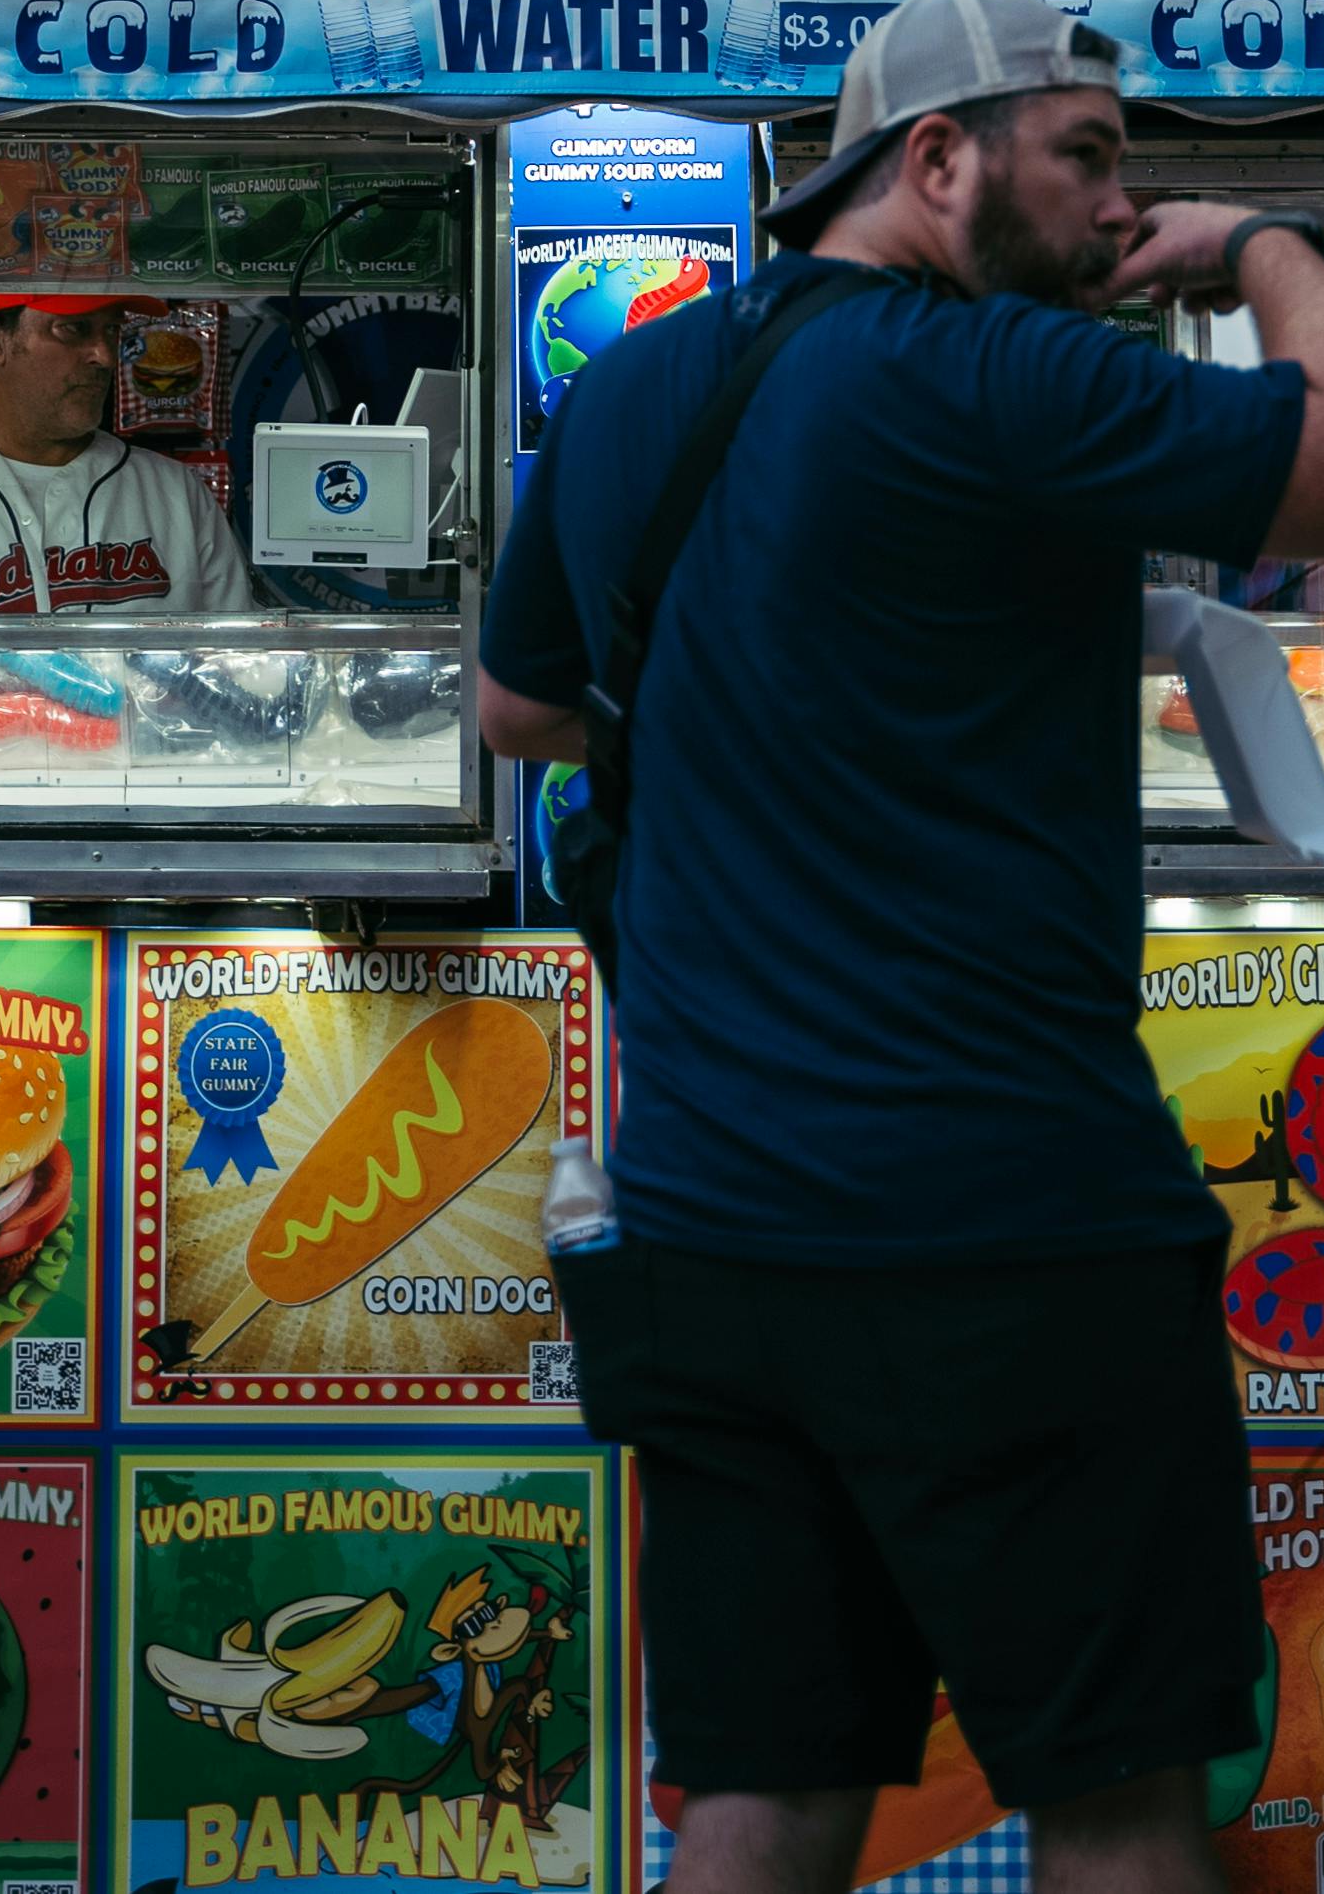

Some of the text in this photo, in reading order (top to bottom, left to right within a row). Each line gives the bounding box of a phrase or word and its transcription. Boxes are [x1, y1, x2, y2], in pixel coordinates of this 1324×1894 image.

[551, 137, 696, 157] GUMMY WORM
[524, 162, 724, 182] GUMMY SOUR WORM
[364, 1276, 553, 1314] CORN DOG
[184, 1791, 540, 1888] BANANA
